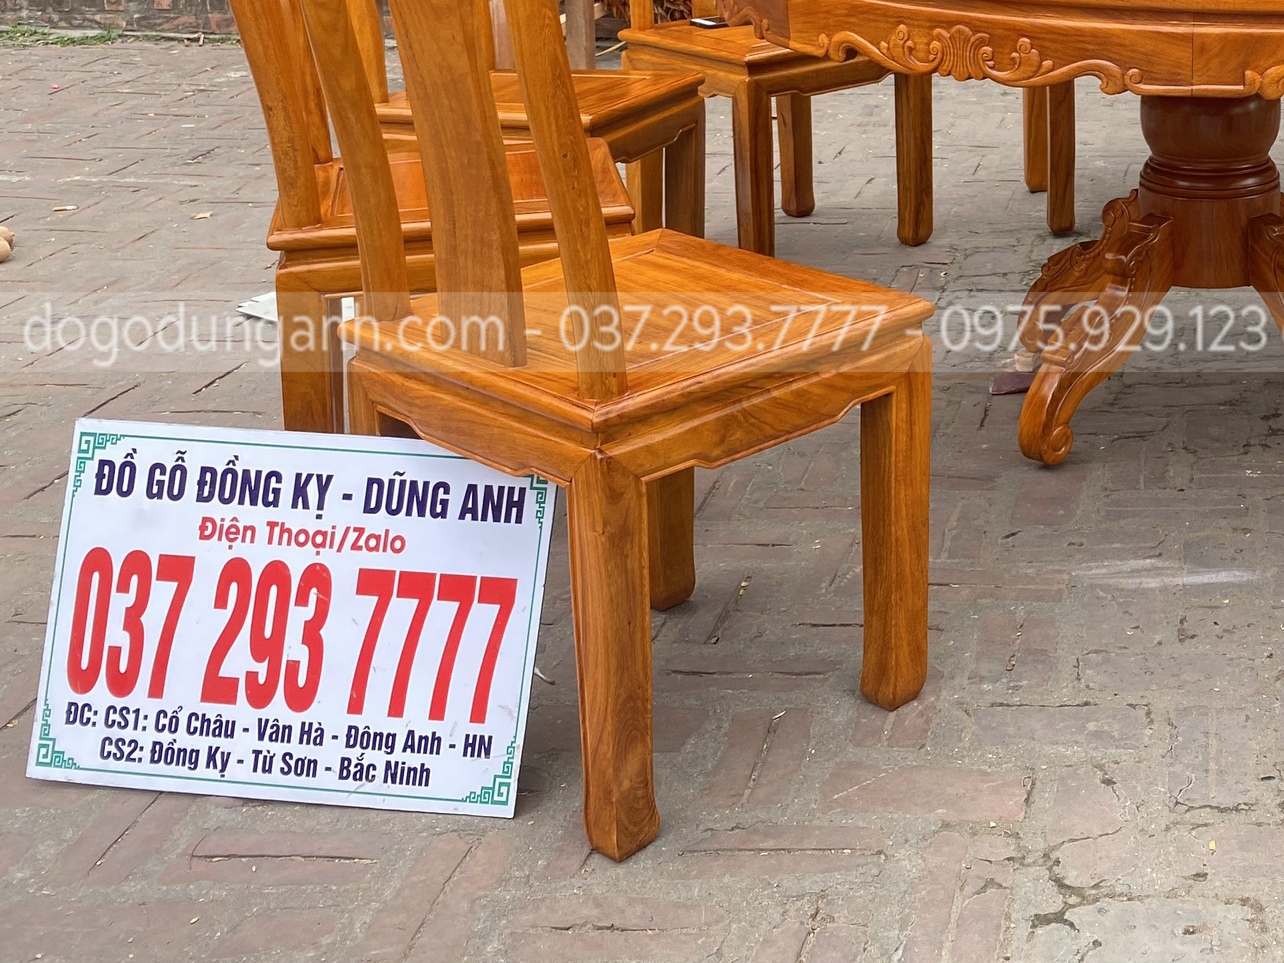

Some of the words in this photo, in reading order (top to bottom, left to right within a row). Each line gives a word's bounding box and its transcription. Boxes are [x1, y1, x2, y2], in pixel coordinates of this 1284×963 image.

[94, 448, 137, 497] ĐỒ
[146, 451, 187, 501] GỖ
[196, 455, 282, 507] ĐỒNG
[291, 473, 333, 519] KỴ
[363, 472, 450, 519] DŨNG
[458, 484, 526, 524] ANH
[199, 517, 256, 549] Điện
[267, 521, 405, 555] Thoại/Zalo
[68, 547, 195, 699] 037
[201, 557, 332, 713] 293
[347, 569, 517, 723] 7777
[66, 702, 97, 726] ĐC:
[105, 706, 148, 731] CS1:
[155, 706, 182, 733] Cổ
[187, 712, 235, 738] Châu
[258, 718, 292, 743] Vân
[299, 722, 324, 746] Hà
[346, 725, 396, 754] Đông
[402, 730, 441, 753] Anh
[463, 734, 492, 758] HN
[100, 737, 143, 762] CS2:
[150, 739, 199, 770] Đồng
[206, 746, 231, 777] Kỵ
[252, 750, 275, 773] Từ
[280, 752, 317, 777] Sơn
[339, 753, 376, 782] Bắc
[383, 761, 430, 786] Ninh
